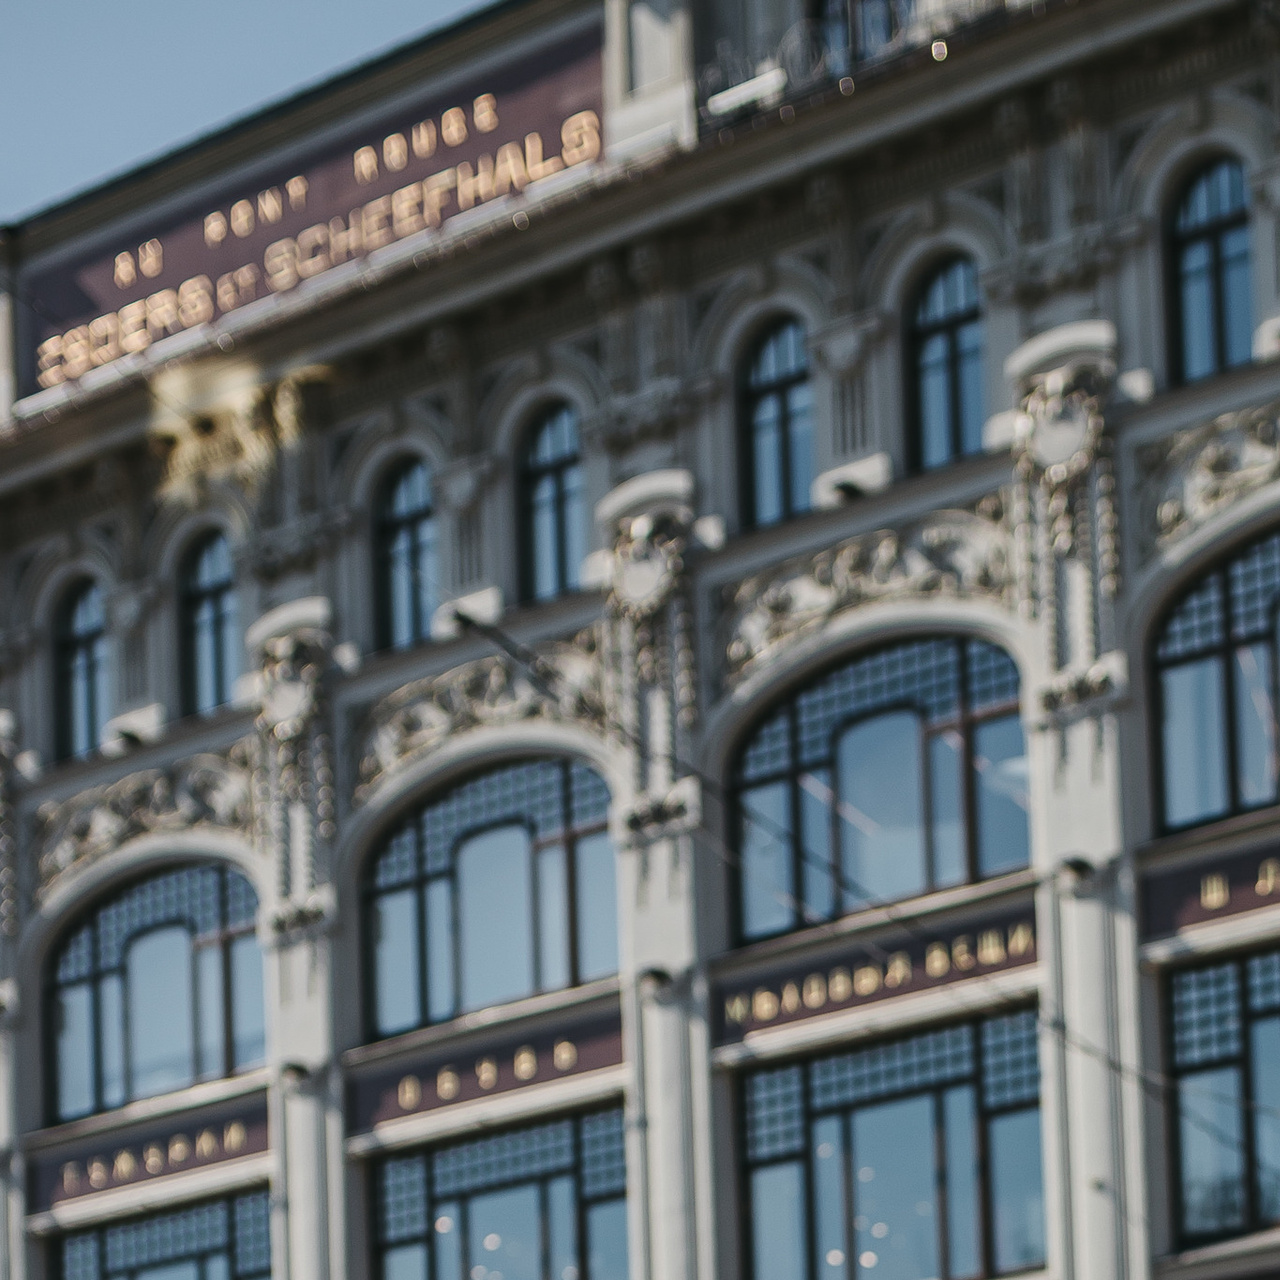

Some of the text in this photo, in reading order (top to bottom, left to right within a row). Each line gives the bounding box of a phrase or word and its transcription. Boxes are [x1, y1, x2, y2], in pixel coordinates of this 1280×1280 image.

[36, 274, 215, 389] ESDERS
[264, 109, 601, 293] SCHEEFHALS
[113, 92, 500, 290] AU PONT ROUGE
